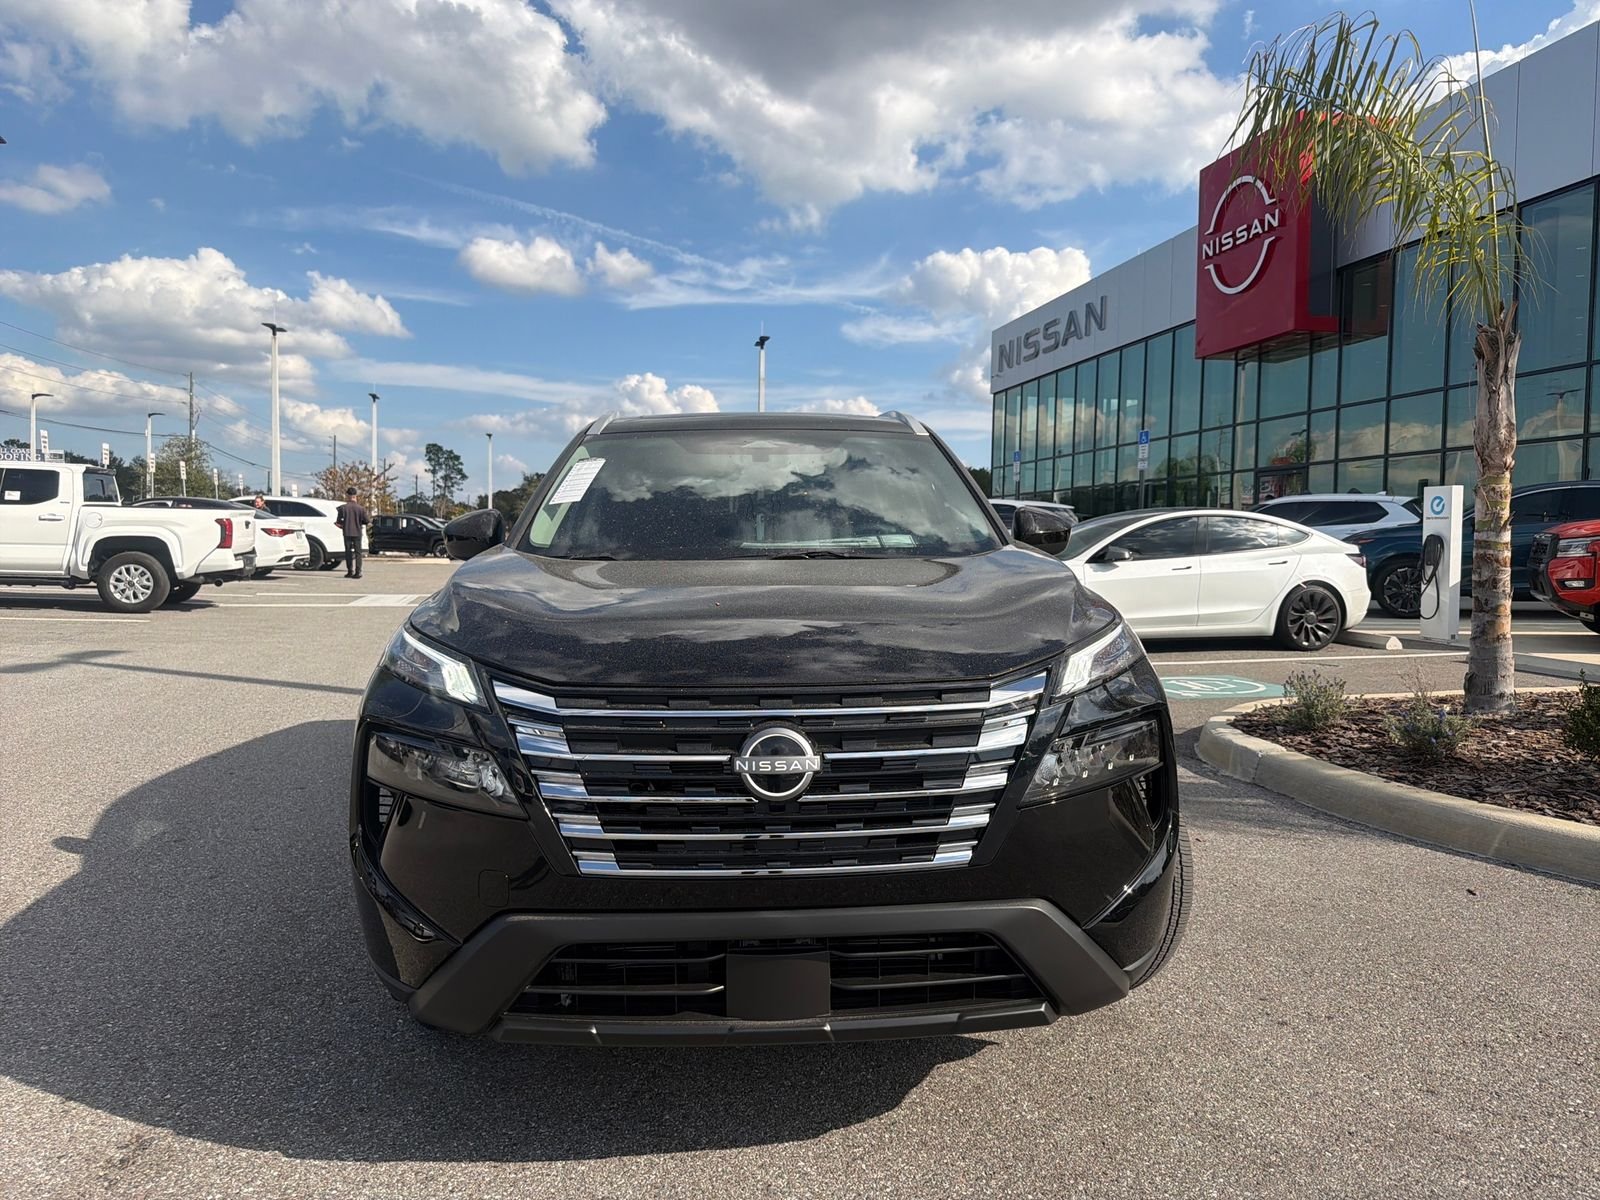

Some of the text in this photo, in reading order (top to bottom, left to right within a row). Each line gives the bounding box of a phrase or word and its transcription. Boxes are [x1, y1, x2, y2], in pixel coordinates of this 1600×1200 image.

[1203, 209, 1279, 260] NISSAN
[998, 295, 1107, 373] NISSAN
[735, 759, 818, 771] NISSAN
